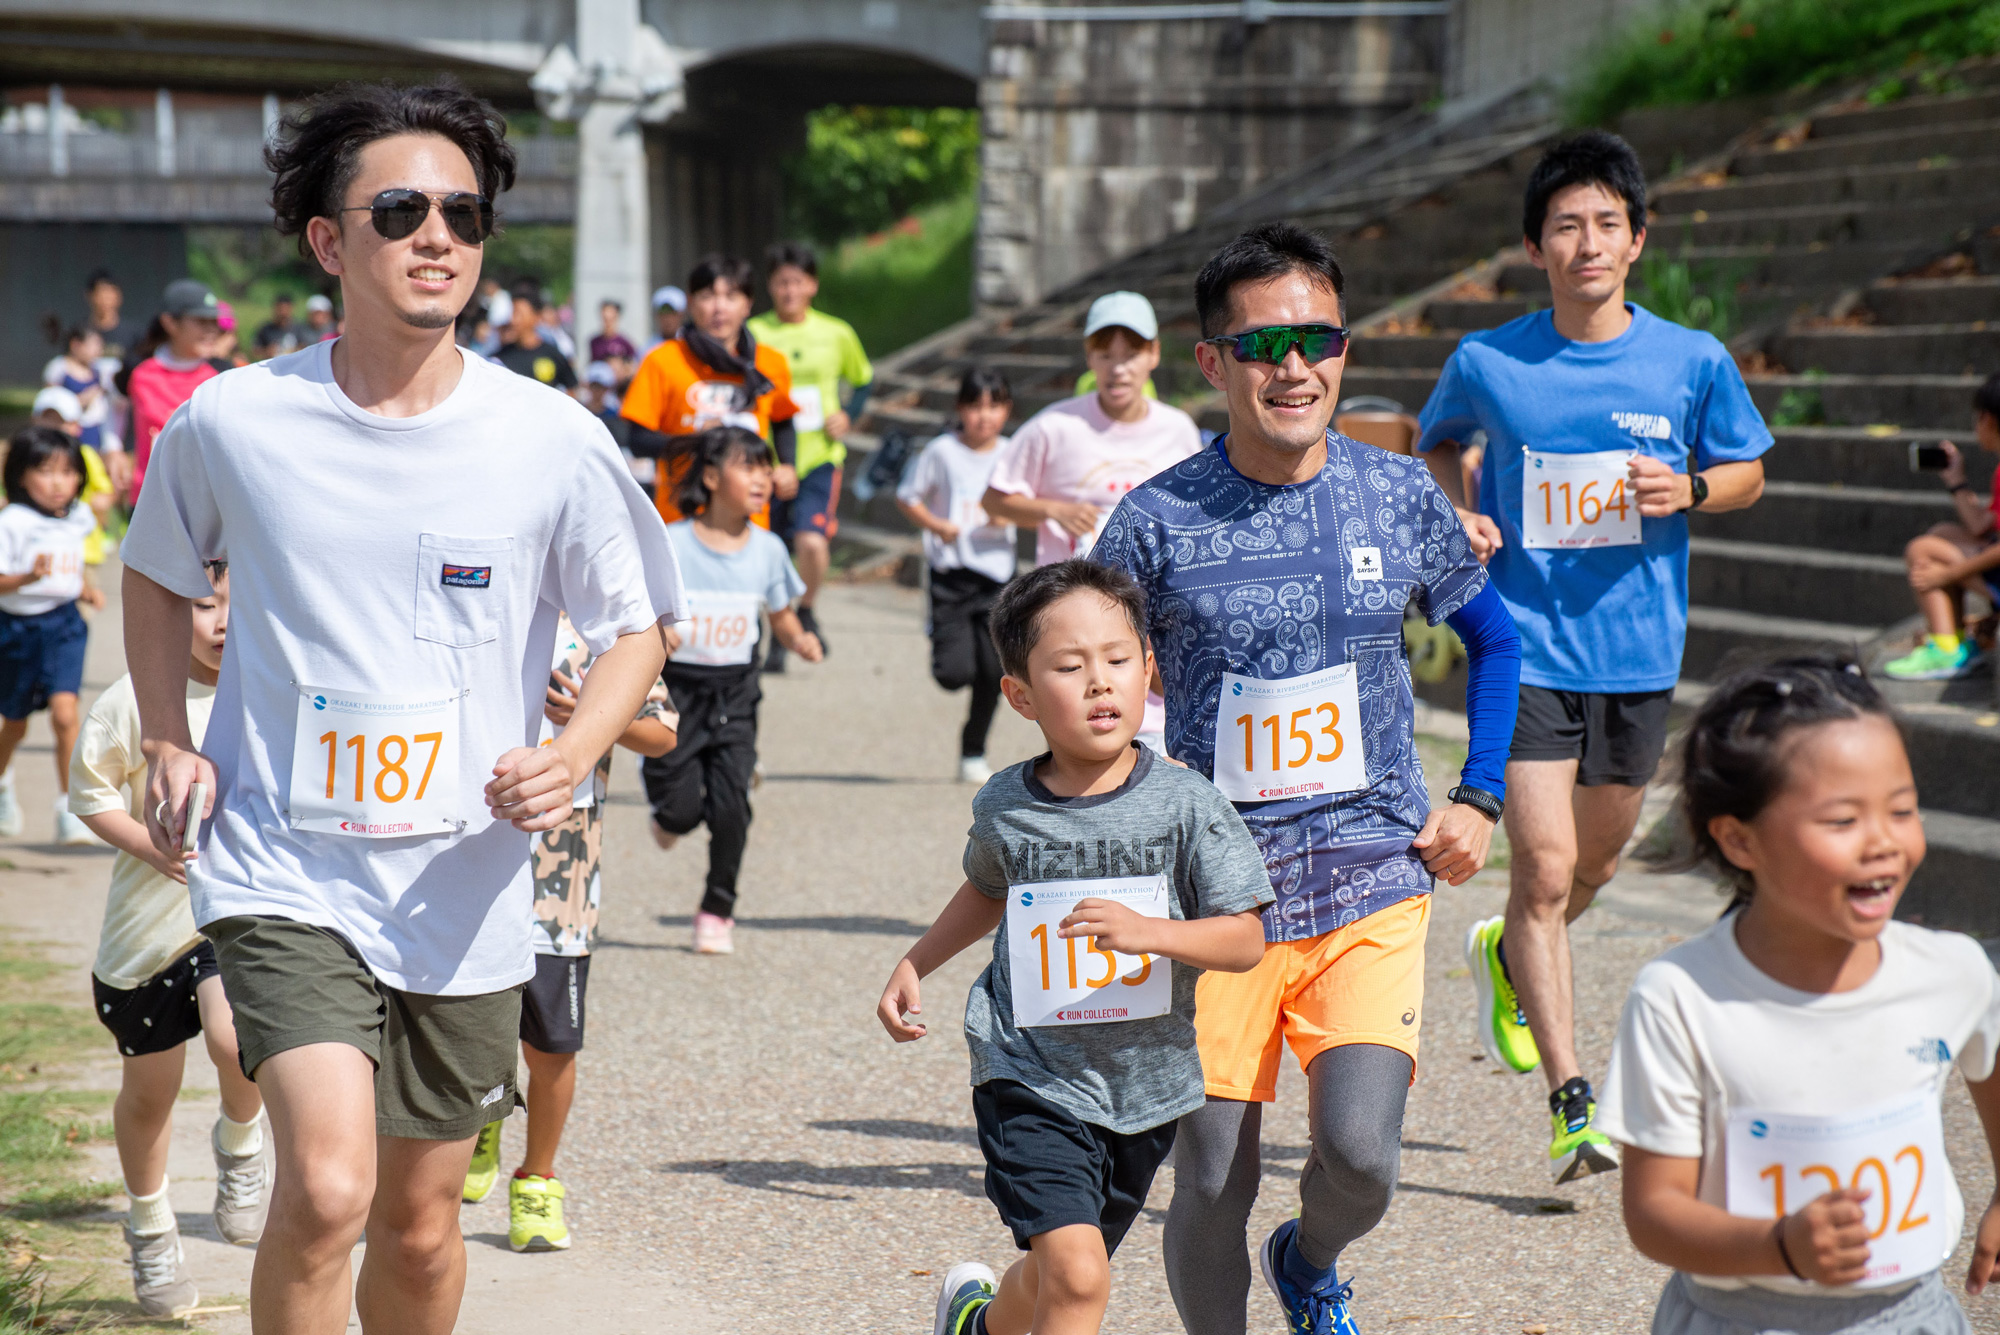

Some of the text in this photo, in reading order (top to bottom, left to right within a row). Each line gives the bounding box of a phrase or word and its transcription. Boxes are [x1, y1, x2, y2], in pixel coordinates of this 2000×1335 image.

[1538, 478, 1630, 525] 1164
[1168, 518, 1234, 537] FOREVER RUNNING
[1313, 522, 1319, 531] OF
[1174, 559, 1228, 573] FOREVER RUNNING
[1458, 561, 1464, 569] OF
[445, 577, 485, 585] patagonia
[690, 614, 748, 649] 1169
[1246, 673, 1345, 694] OKAZAKI RIVERSIDE MARATHON
[330, 699, 446, 711] OKAZAKI RIVERSIDE MARATHON
[1236, 702, 1344, 772] 1153
[319, 730, 443, 803] 1187
[1269, 782, 1324, 797] RUN COLLECTION
[351, 822, 413, 834] RUN COLLECTION
[1001, 837, 1168, 879] MIZUNO
[1037, 886, 1154, 899] OKAZAKI RIVERSIDE MARATHON
[1275, 916, 1281, 924] IS
[1067, 1007, 1128, 1020] RUN COLLECTION
